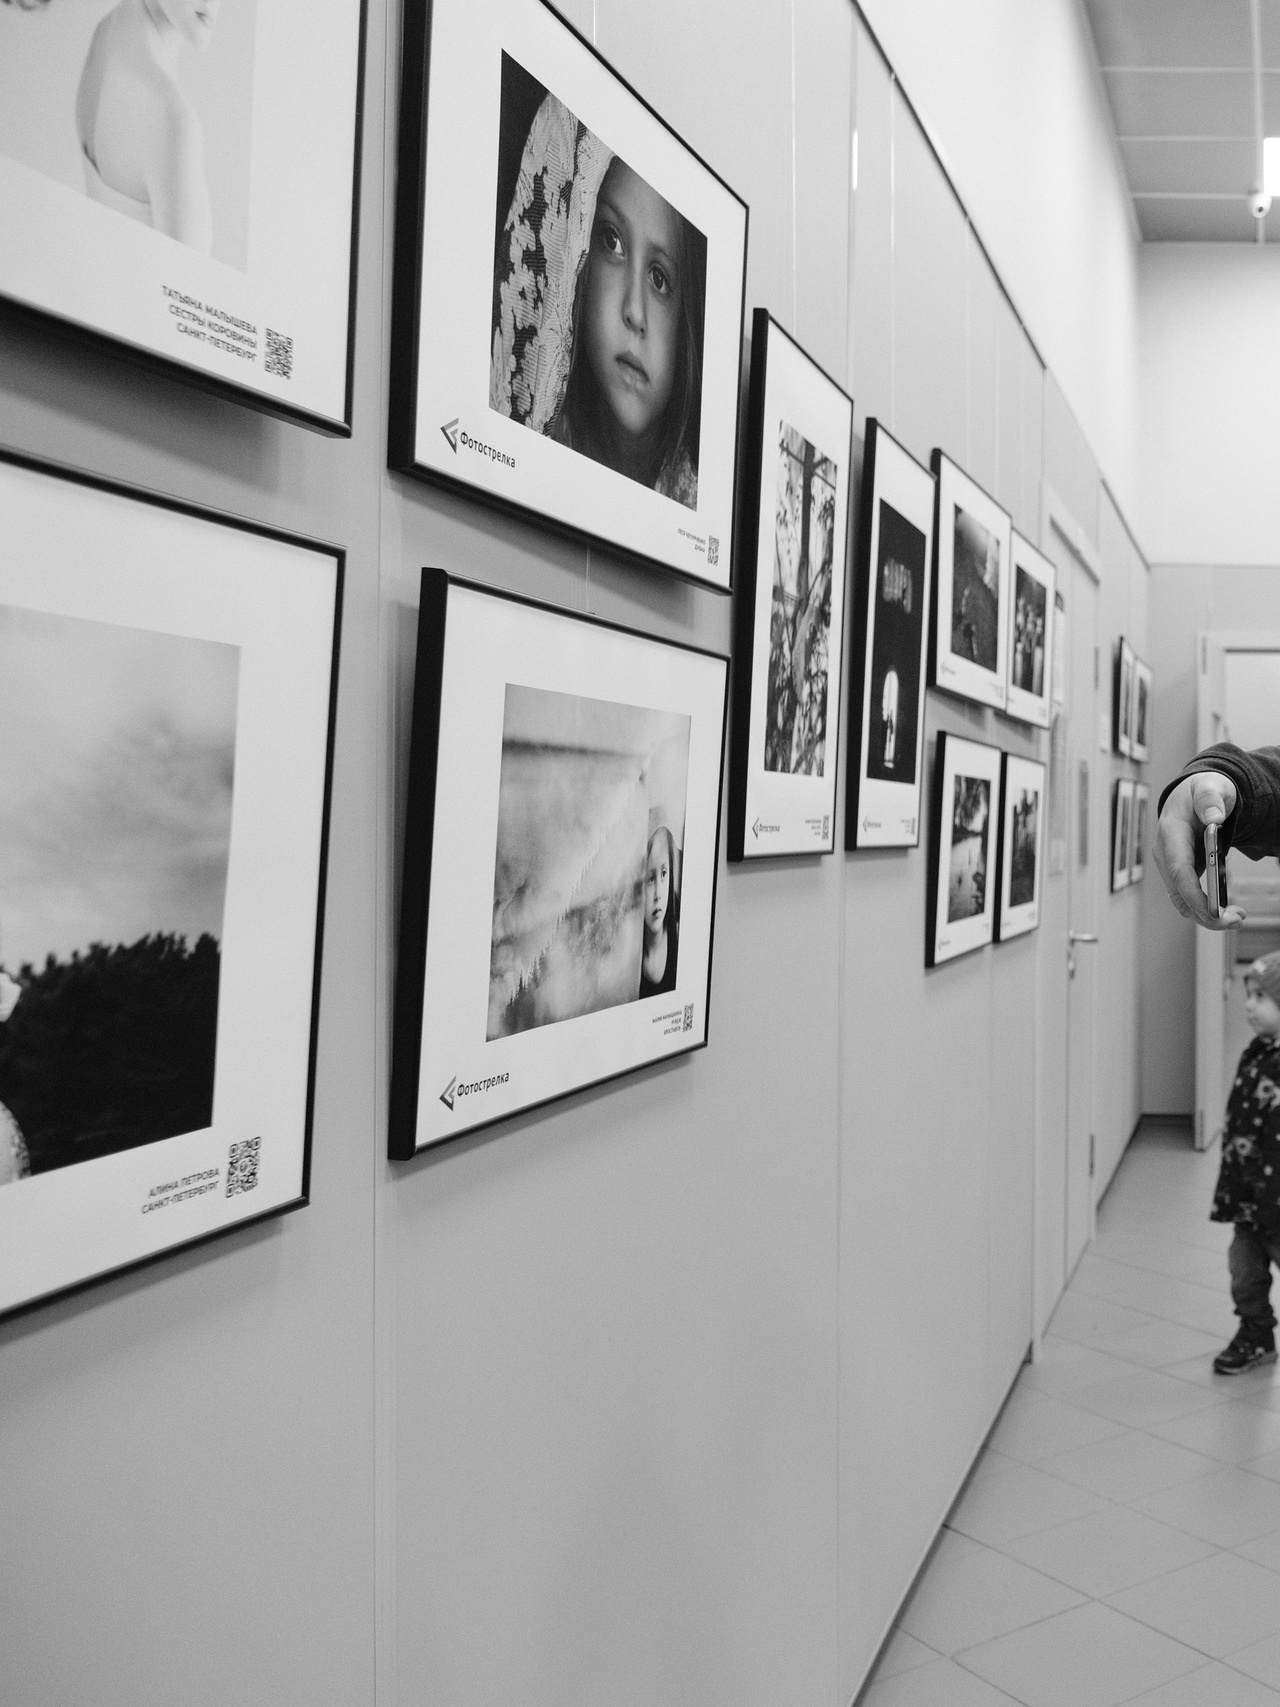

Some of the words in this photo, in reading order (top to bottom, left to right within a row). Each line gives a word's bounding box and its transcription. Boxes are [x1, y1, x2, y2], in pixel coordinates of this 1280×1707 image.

[162, 285, 203, 312] ТАТЬЯНА
[205, 304, 258, 335] МАЛЫШЕВА
[169, 304, 206, 327] СЕСТРЫ
[207, 320, 257, 349] КОРОВИНЫ
[177, 322, 257, 362] САНКТ-ПЕТЕРБУРГ
[460, 431, 516, 468] Фотострелка
[457, 1072, 509, 1098] Фотострелка
[141, 1180, 220, 1214] САНКТ-ПЕТЕРБУРГ
[148, 1180, 179, 1198] АЛИНА
[181, 1168, 220, 1188] ПЕТРОВА
